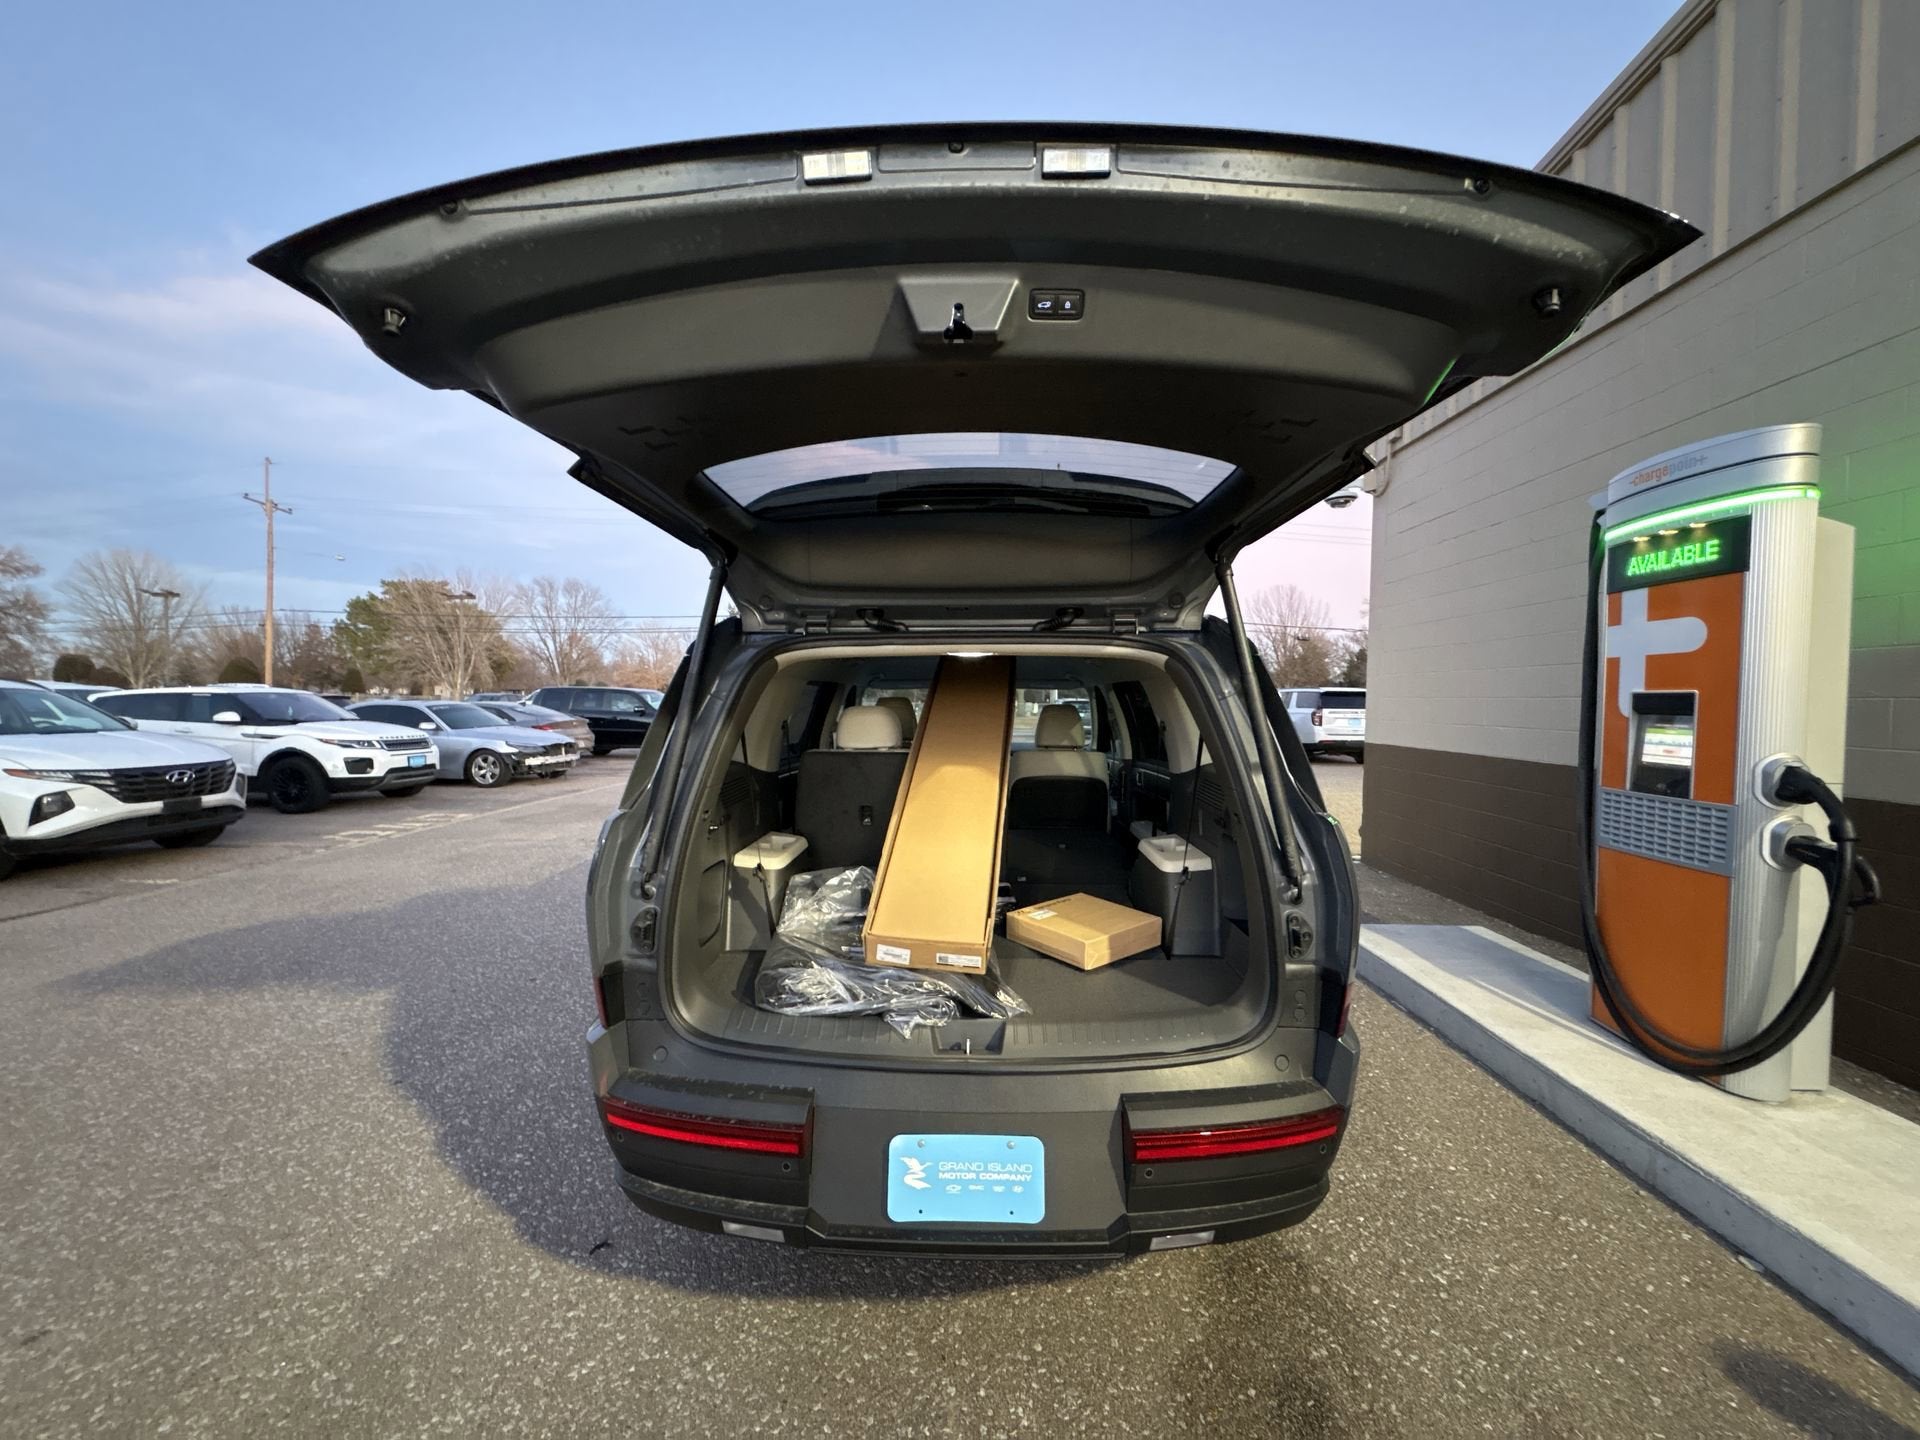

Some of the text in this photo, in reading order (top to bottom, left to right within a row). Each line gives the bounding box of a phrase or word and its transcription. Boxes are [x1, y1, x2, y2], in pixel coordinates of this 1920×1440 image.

[1627, 539, 1720, 576] AVAILABLE
[938, 1161, 1033, 1173] GRAND ISLAND
[938, 1172, 1032, 1182] MOTOR COMPANY
